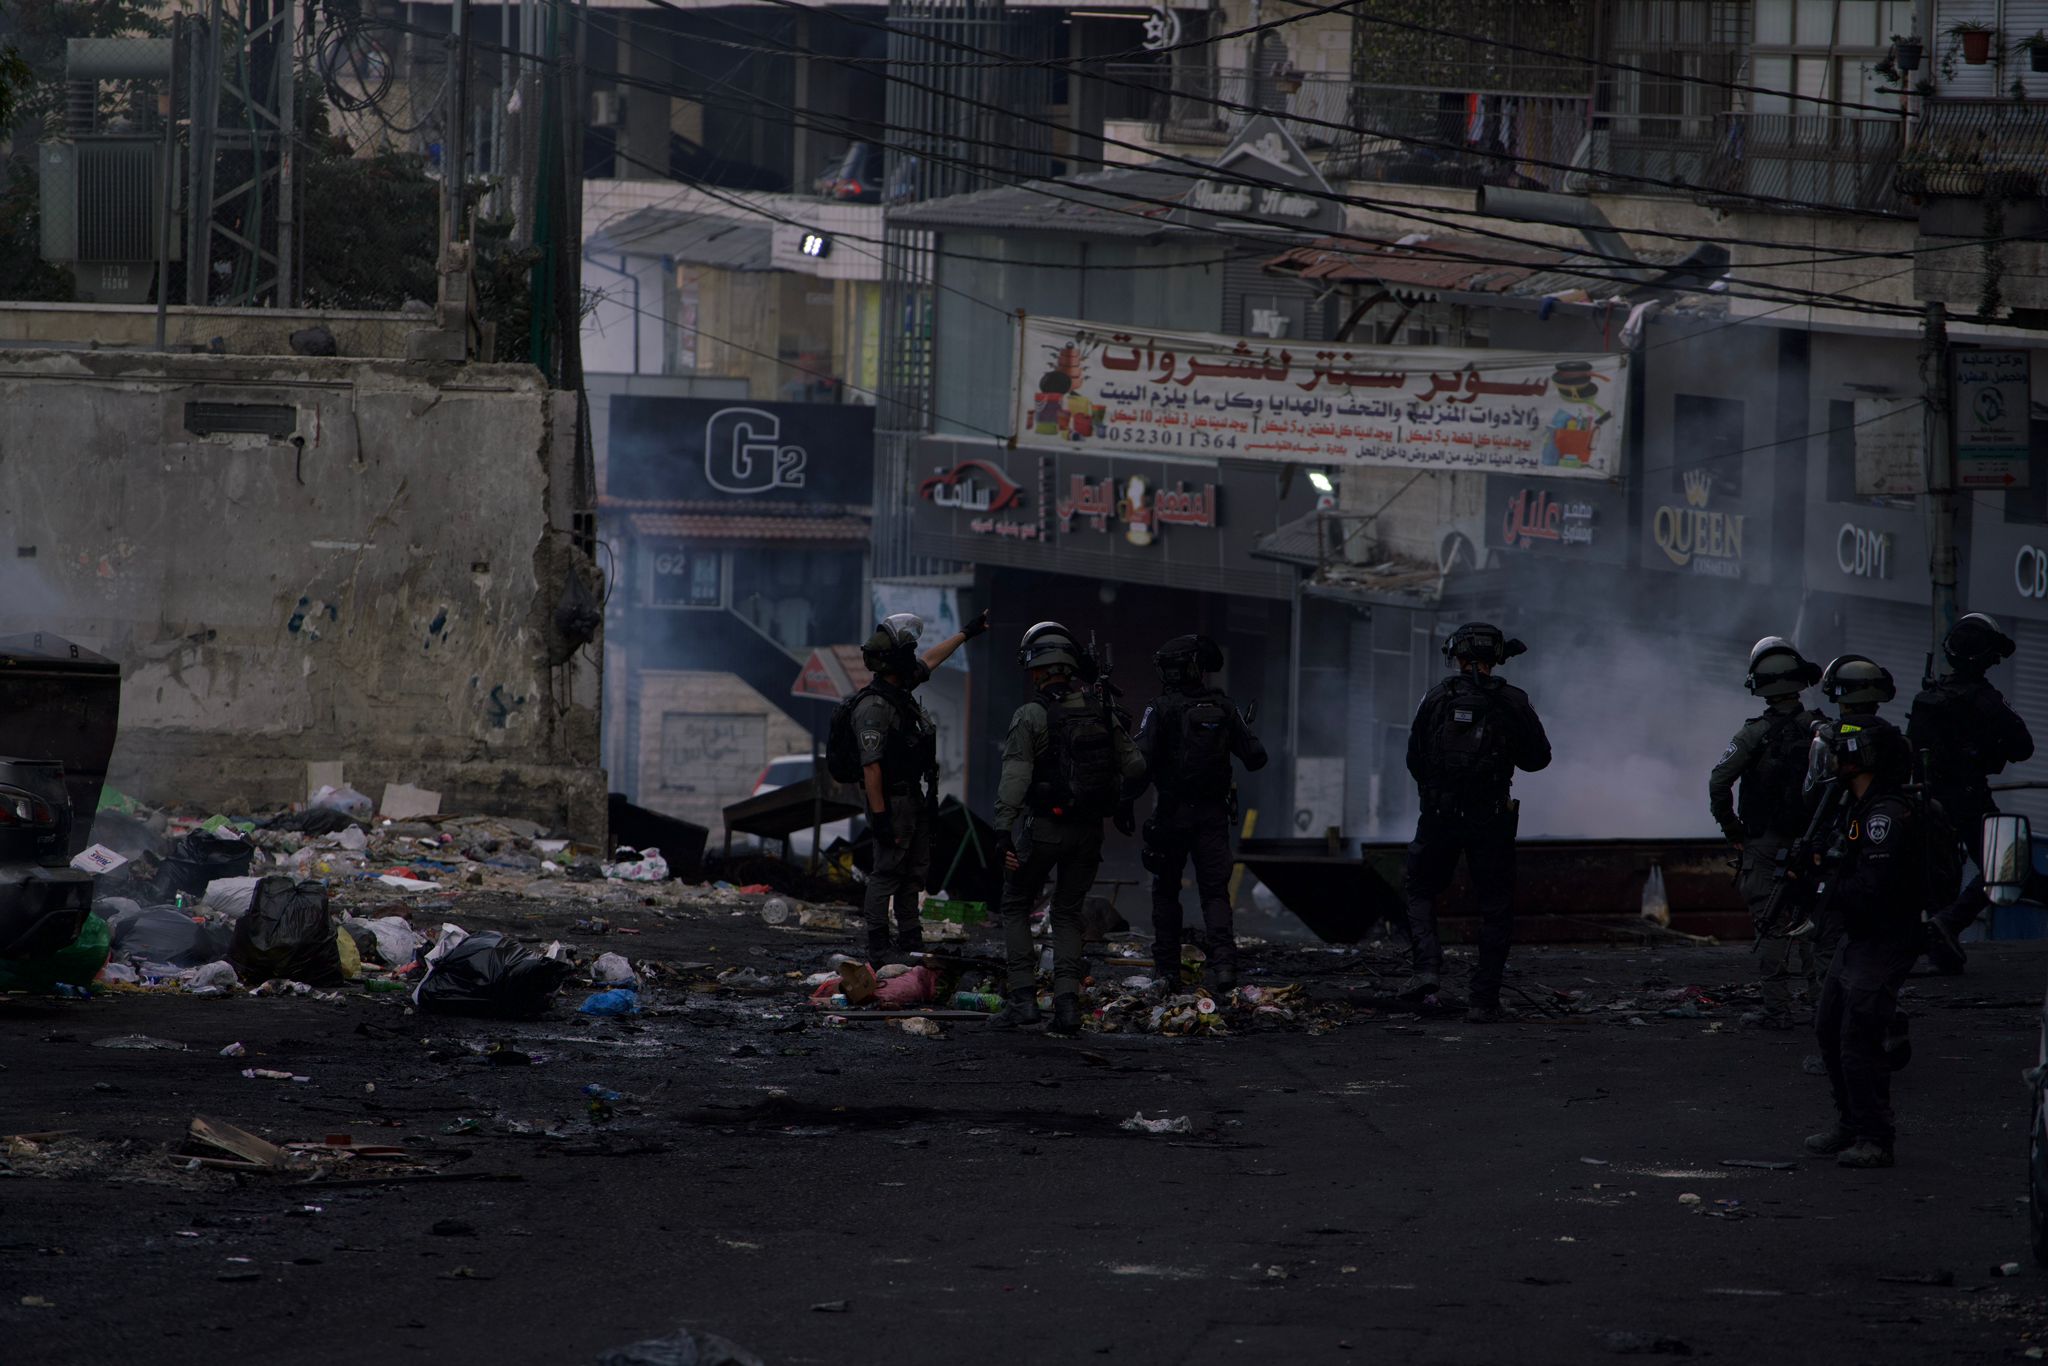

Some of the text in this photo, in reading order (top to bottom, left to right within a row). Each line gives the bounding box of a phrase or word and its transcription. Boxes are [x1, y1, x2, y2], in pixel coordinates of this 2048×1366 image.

[1296, 351, 1407, 392] سنتر
[1414, 362, 1550, 405] سوبر
[1099, 382, 1147, 405] البيت
[1150, 386, 1188, 407] يلزم
[1193, 389, 1211, 406] ما
[1215, 391, 1263, 413] وكل
[1269, 392, 1333, 419] والهدايا
[705, 407, 807, 494] G2
[1109, 427, 1237, 449] 0523011364
[1152, 481, 1215, 536] المطعم
[1504, 488, 1560, 549] عليان
[1654, 505, 1744, 565] QUEEN
[1837, 522, 1886, 579] CBM
[655, 553, 686, 576] G2
